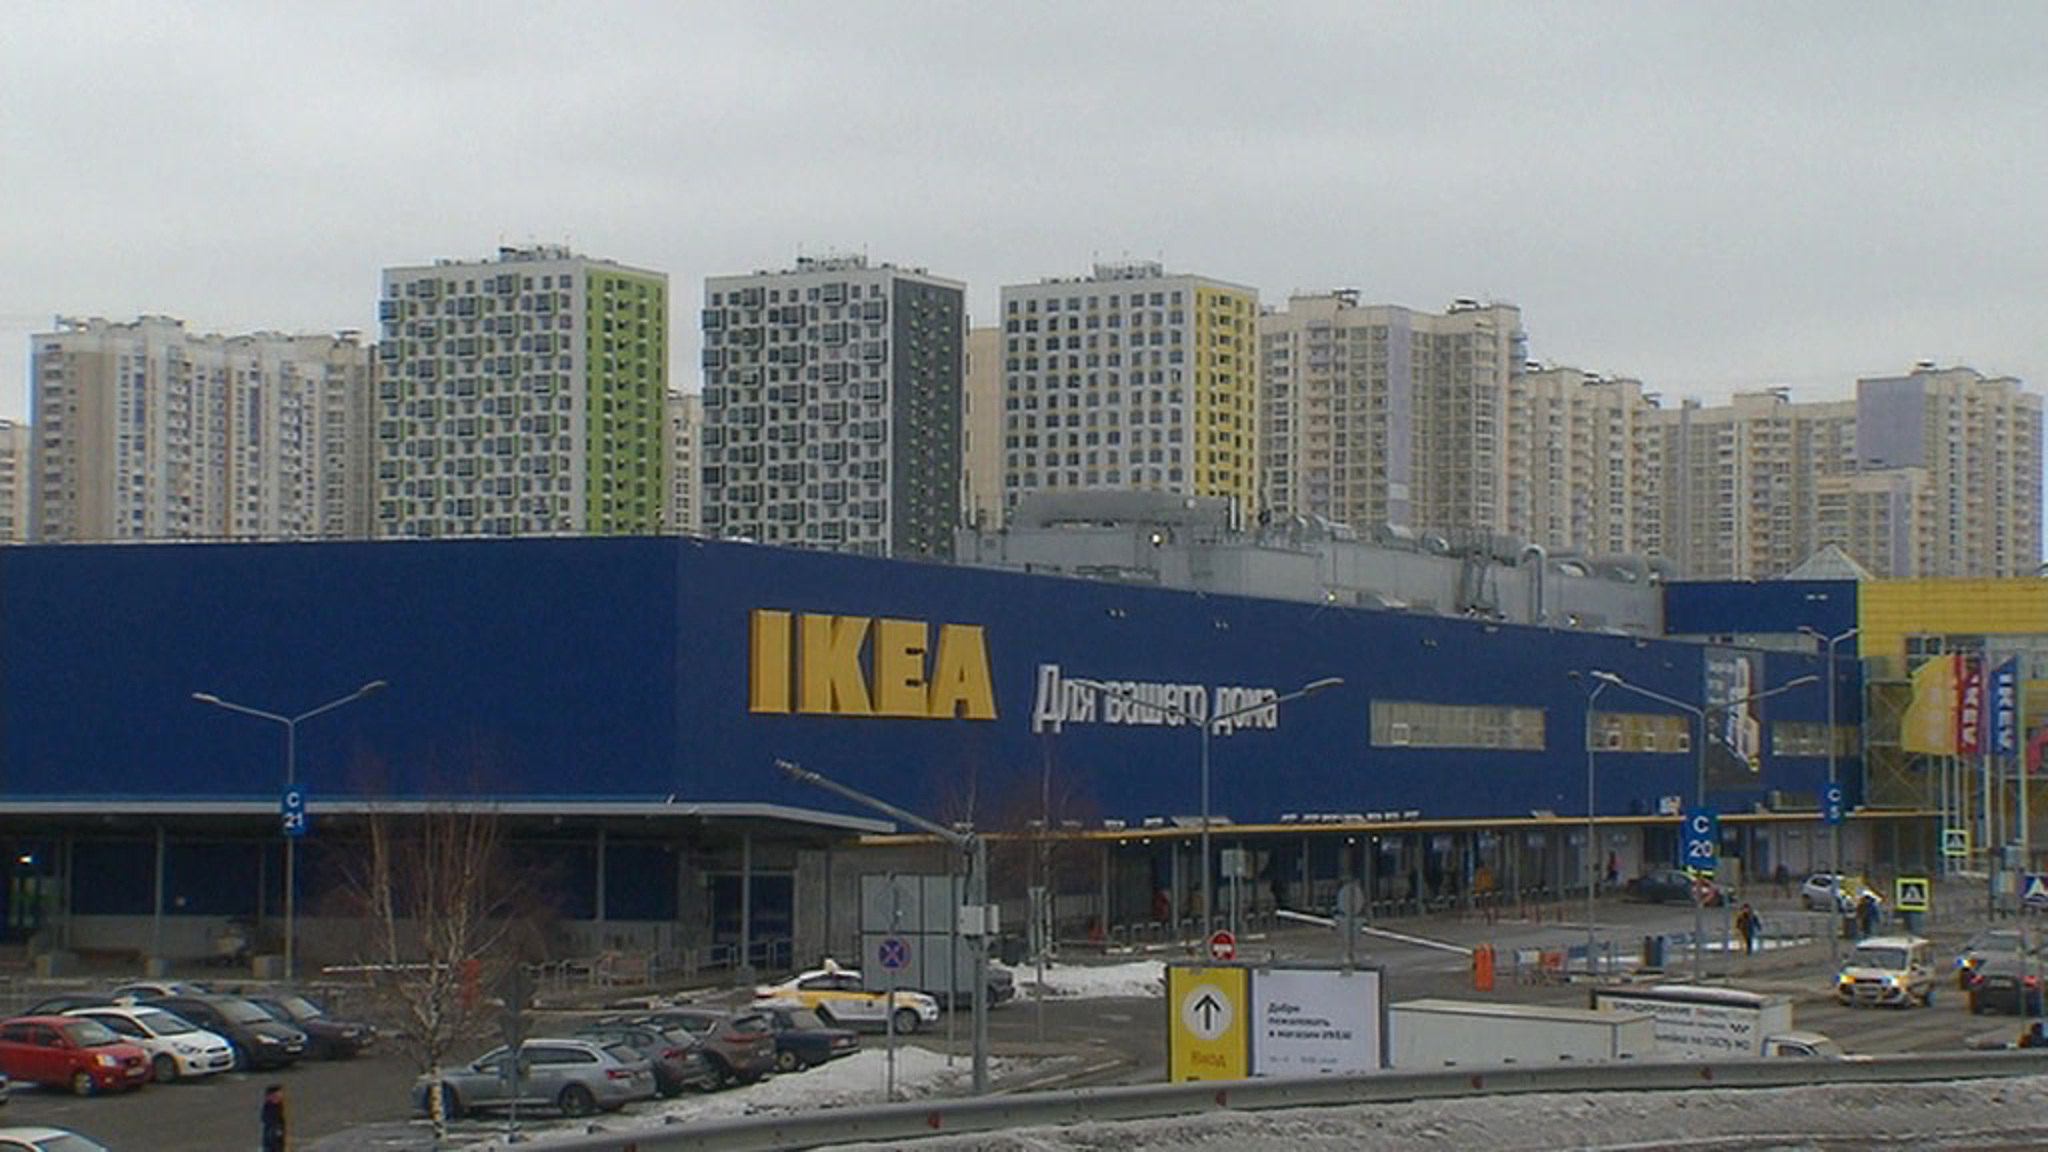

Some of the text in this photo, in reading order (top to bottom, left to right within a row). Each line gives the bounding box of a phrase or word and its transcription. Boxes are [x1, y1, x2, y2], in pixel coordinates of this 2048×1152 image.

[749, 608, 997, 719] IKEA
[1032, 664, 1278, 735] Для вашего дома
[1998, 673, 2014, 748] IKEA
[284, 811, 303, 827] 21
[1689, 839, 1714, 857] 20
[1190, 1050, 1227, 1068] Вход
